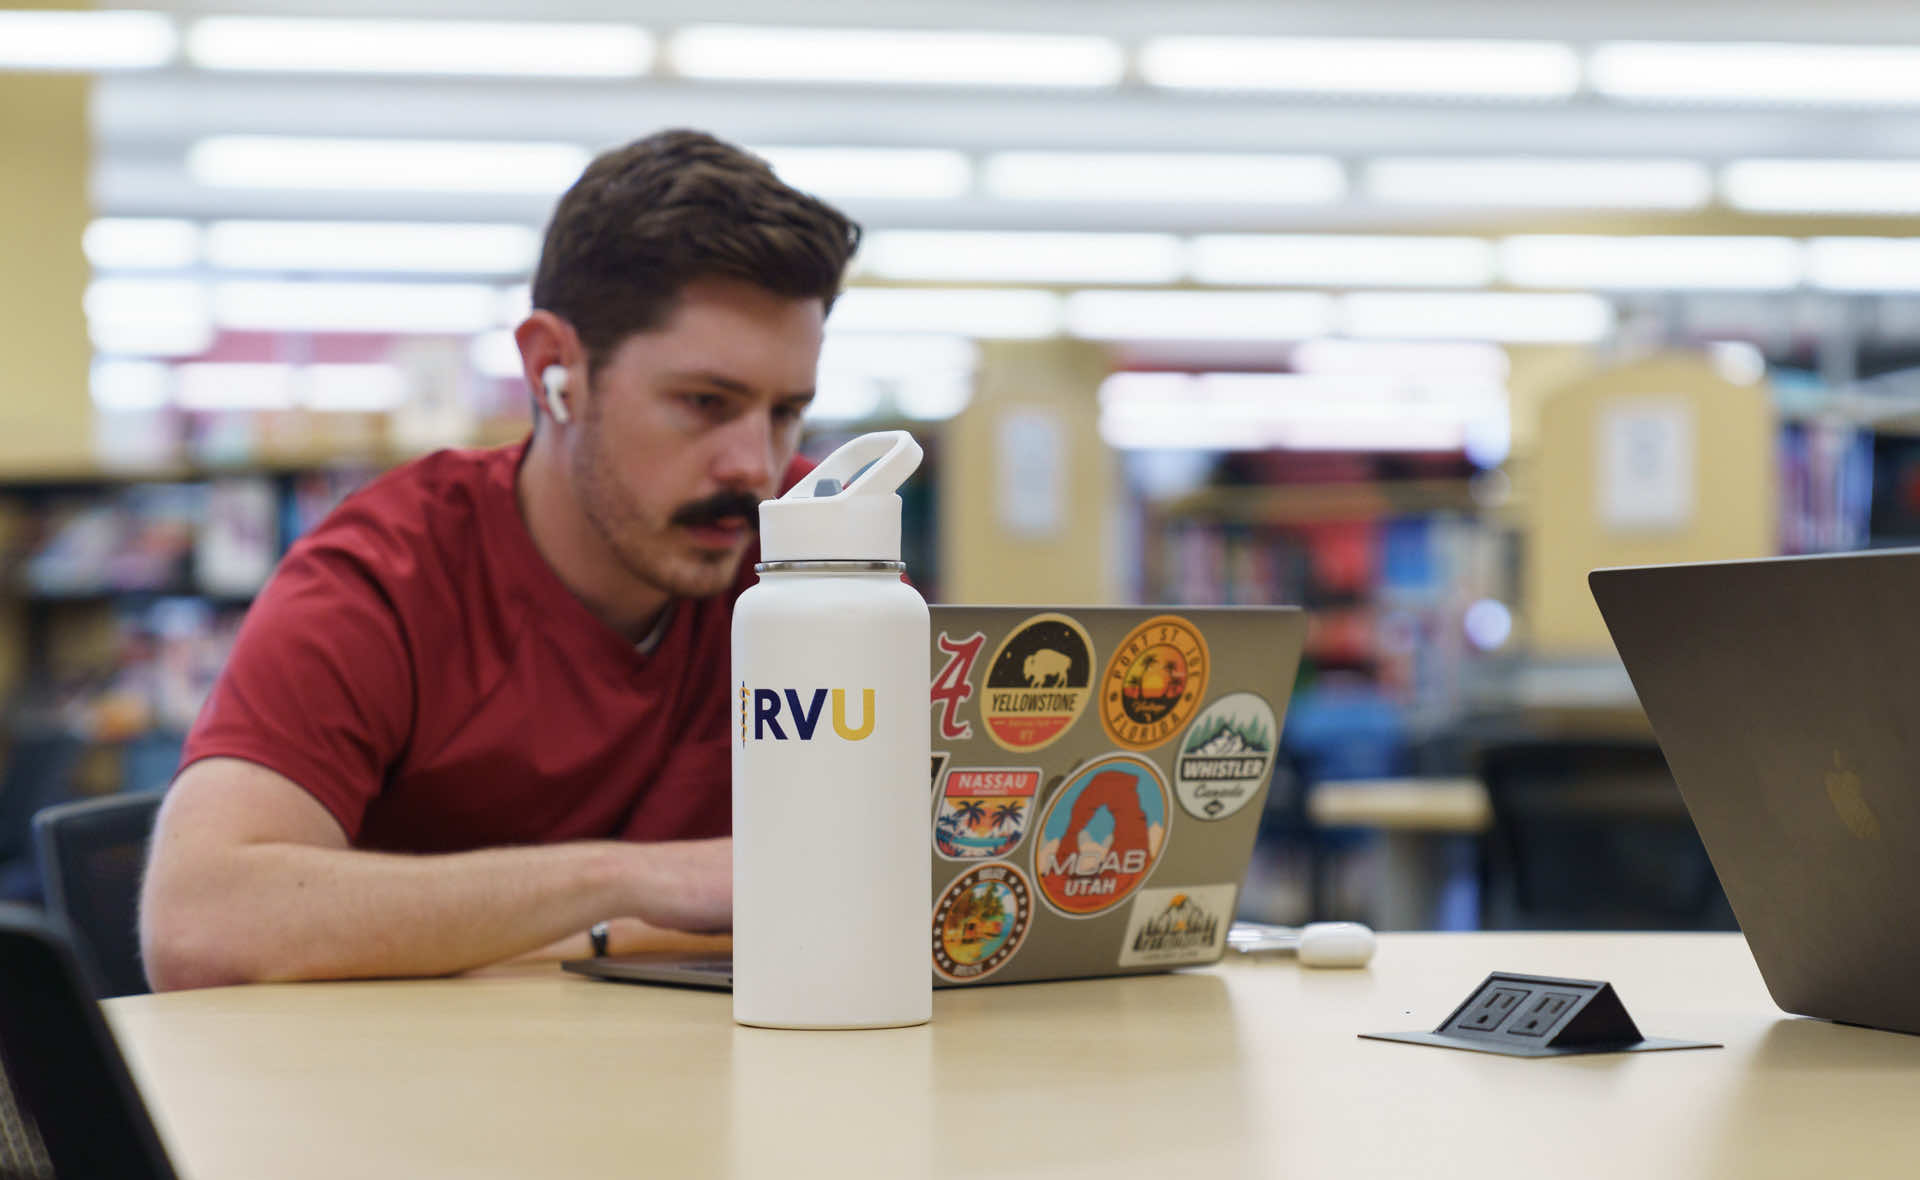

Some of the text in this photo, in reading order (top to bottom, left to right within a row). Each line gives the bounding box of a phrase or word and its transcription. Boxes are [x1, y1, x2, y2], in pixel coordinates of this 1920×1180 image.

[1111, 632, 1148, 680] PORT
[992, 693, 1079, 712] YELLOWSTONE
[754, 688, 875, 741] RVU
[1111, 713, 1182, 740] FLORIDA
[1184, 760, 1264, 778] WHISTLER
[958, 773, 1027, 789] NASSAU
[1193, 783, 1245, 798] Canada
[1047, 849, 1147, 876] MOAB
[1064, 878, 1117, 896] UTAH
